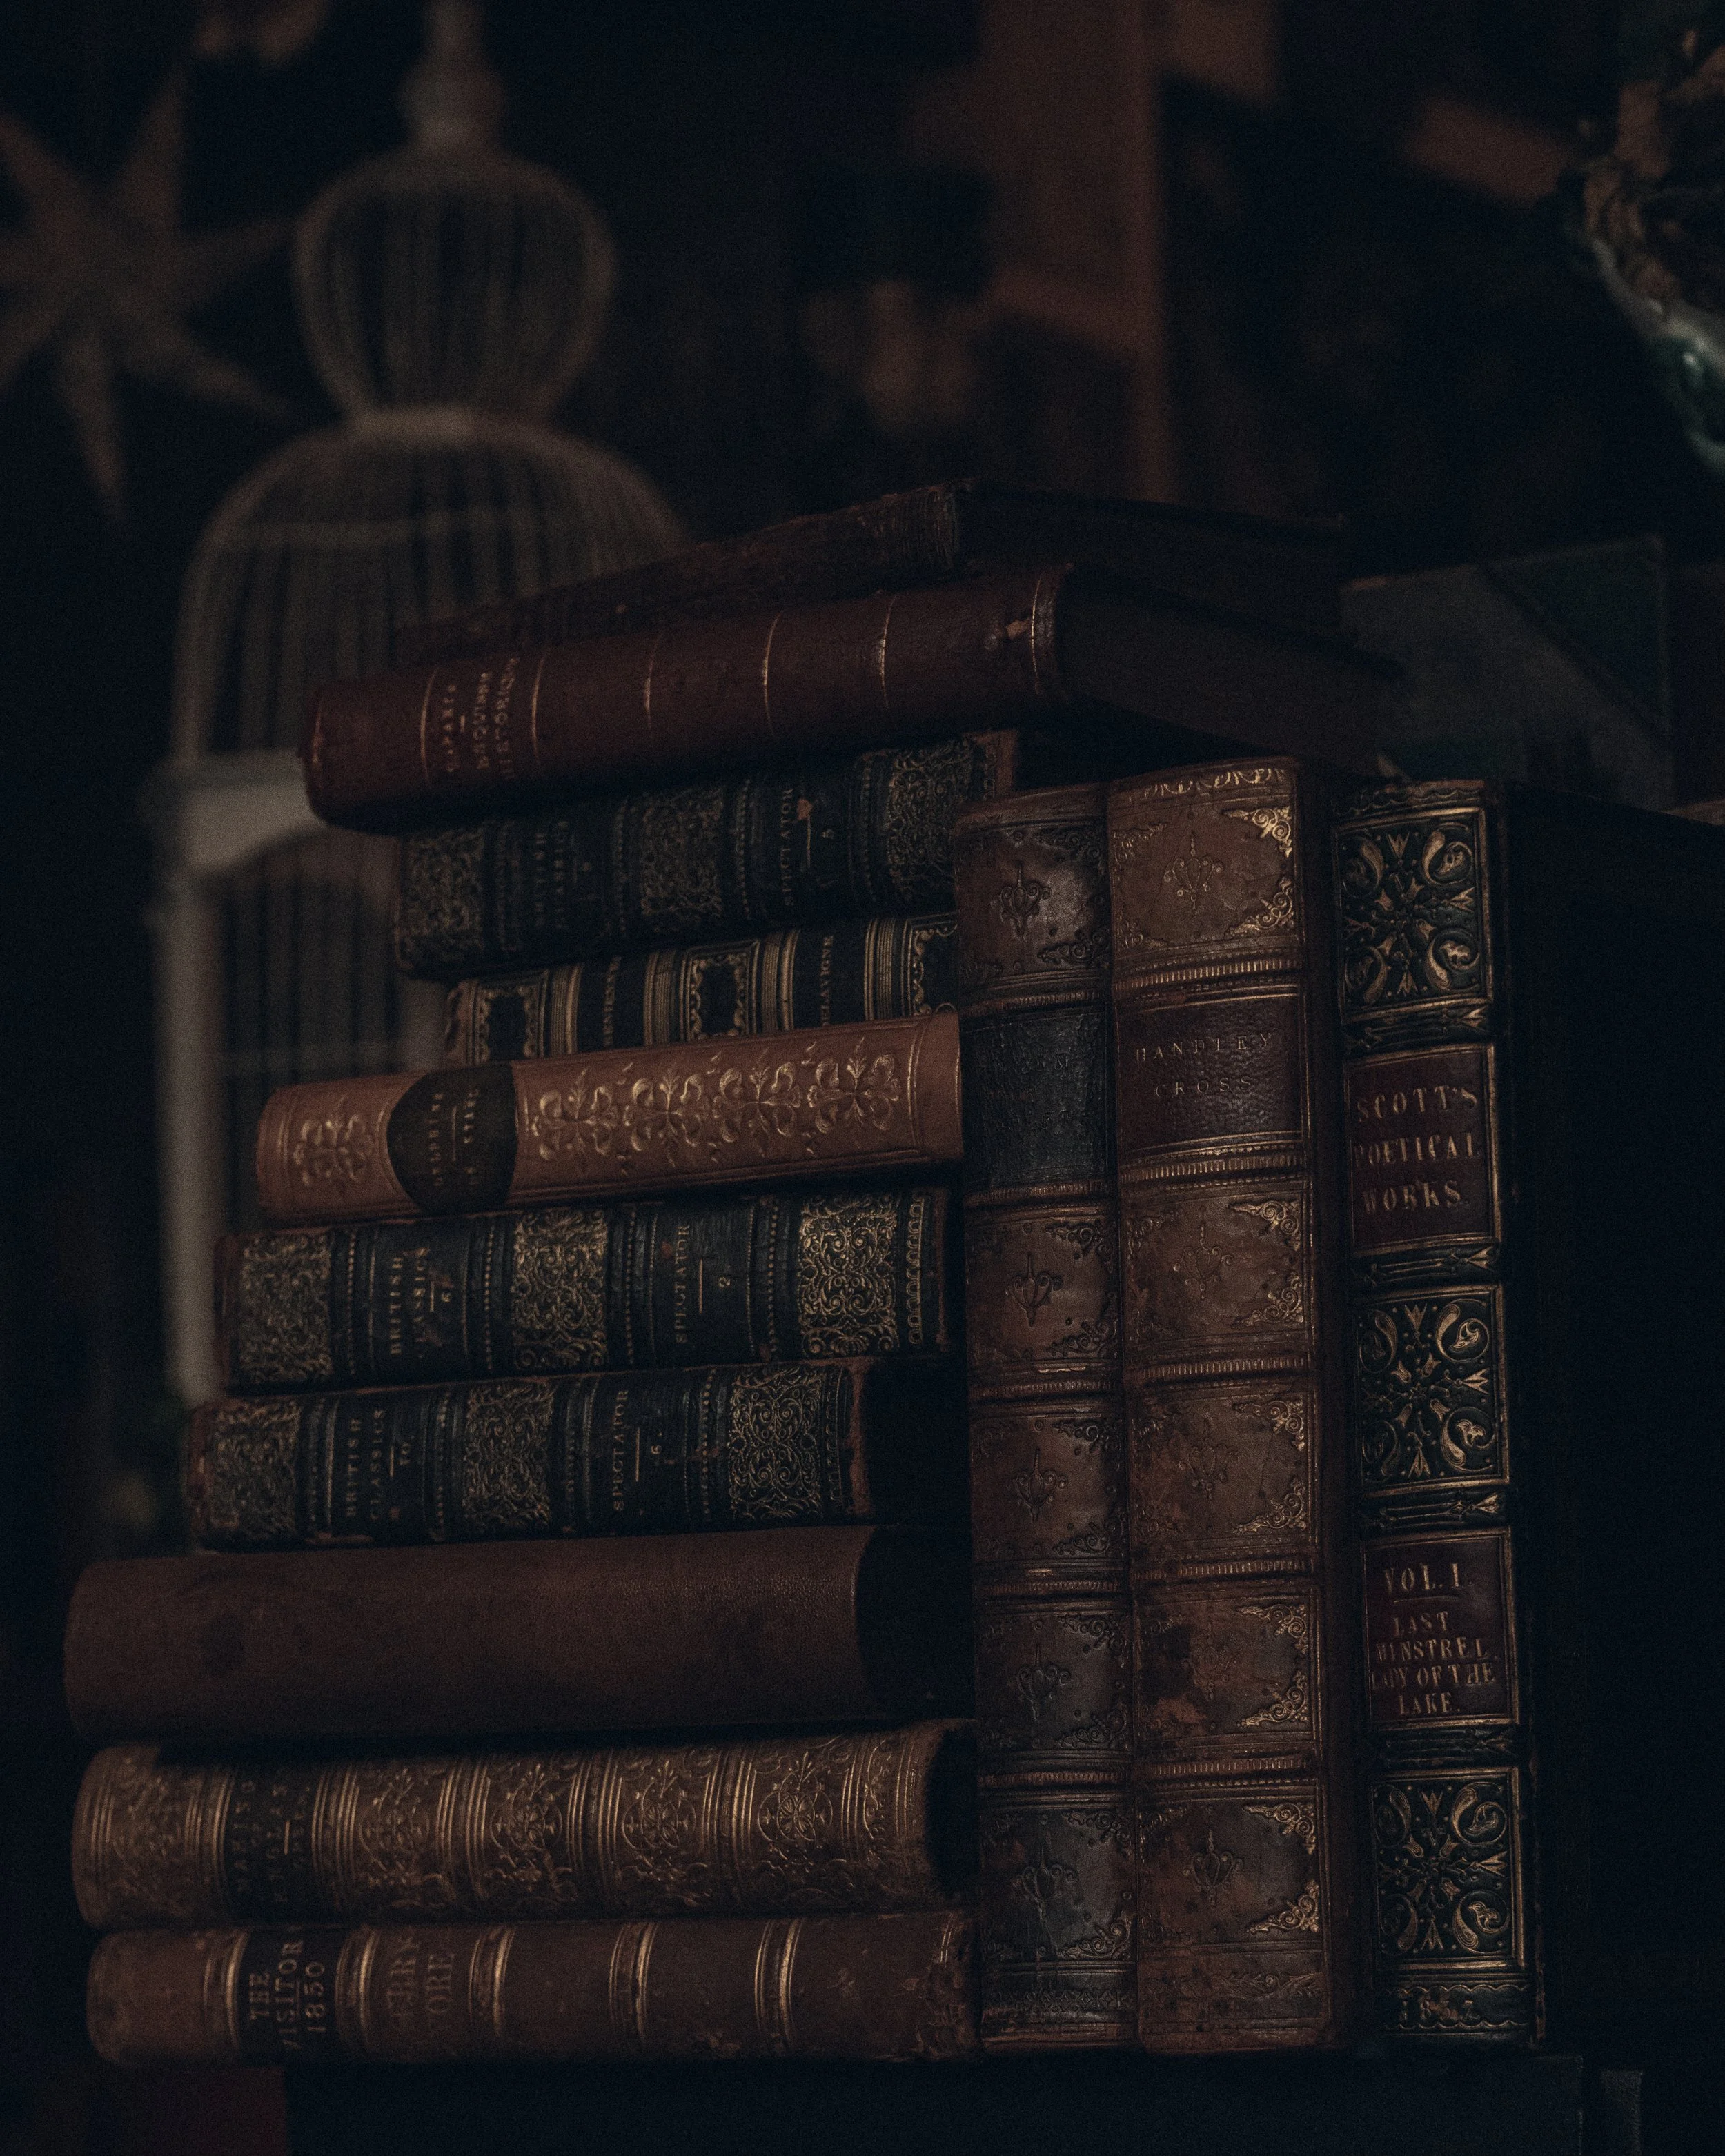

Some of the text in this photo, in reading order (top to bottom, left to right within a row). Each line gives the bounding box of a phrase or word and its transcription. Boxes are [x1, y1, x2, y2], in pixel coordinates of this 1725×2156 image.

[779, 788, 794, 907] SPECTATOR
[1136, 1032, 1270, 1062] HANDLEY
[1155, 1076, 1252, 1098] CROSS
[1357, 1085, 1478, 1123] SCOTT'S
[1354, 1132, 1480, 1167] POETICAL
[389, 1257, 404, 1356] BRITISH
[674, 1225, 691, 1343] SPECTATOR
[345, 1418, 362, 1518] BRITISH
[370, 1408, 384, 1521] CLASSICS
[612, 1389, 628, 1511] SPECTATOR
[1393, 1611, 1448, 1637] LAST
[1417, 1665, 1442, 1687] OF
[1448, 1663, 1496, 1685] THE
[249, 1971, 270, 2020] THE
[275, 1939, 304, 2050] VISITOR
[304, 1961, 326, 2033] 1850
